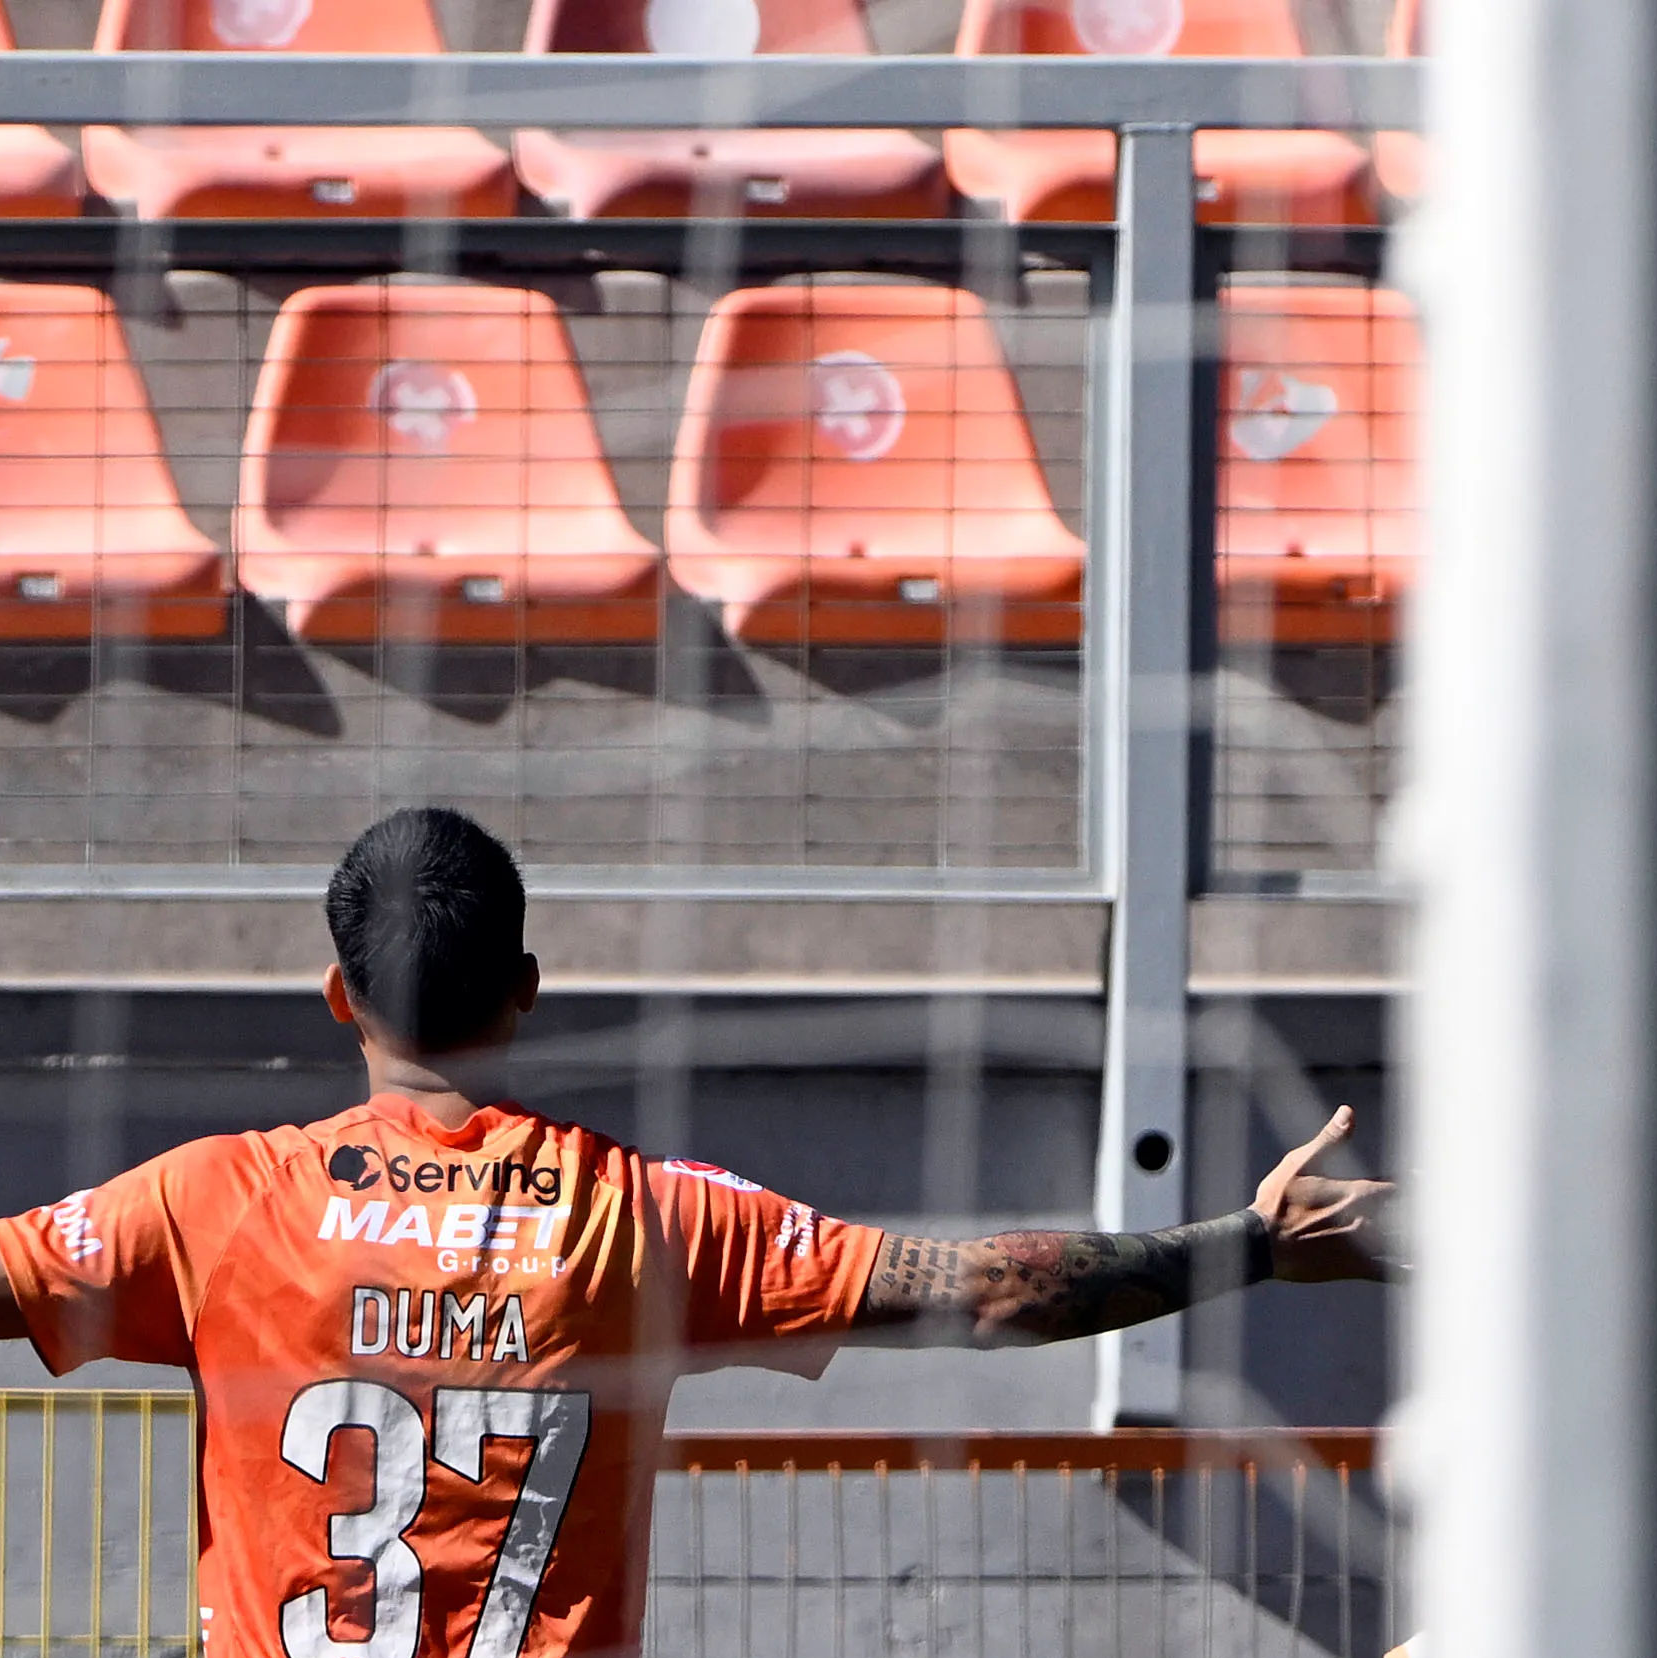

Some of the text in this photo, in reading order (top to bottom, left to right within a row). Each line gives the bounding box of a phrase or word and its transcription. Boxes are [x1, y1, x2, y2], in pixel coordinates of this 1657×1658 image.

[389, 1154, 563, 1206] Serving
[317, 1194, 573, 1251] MABET
[350, 1284, 531, 1364] DUMA
